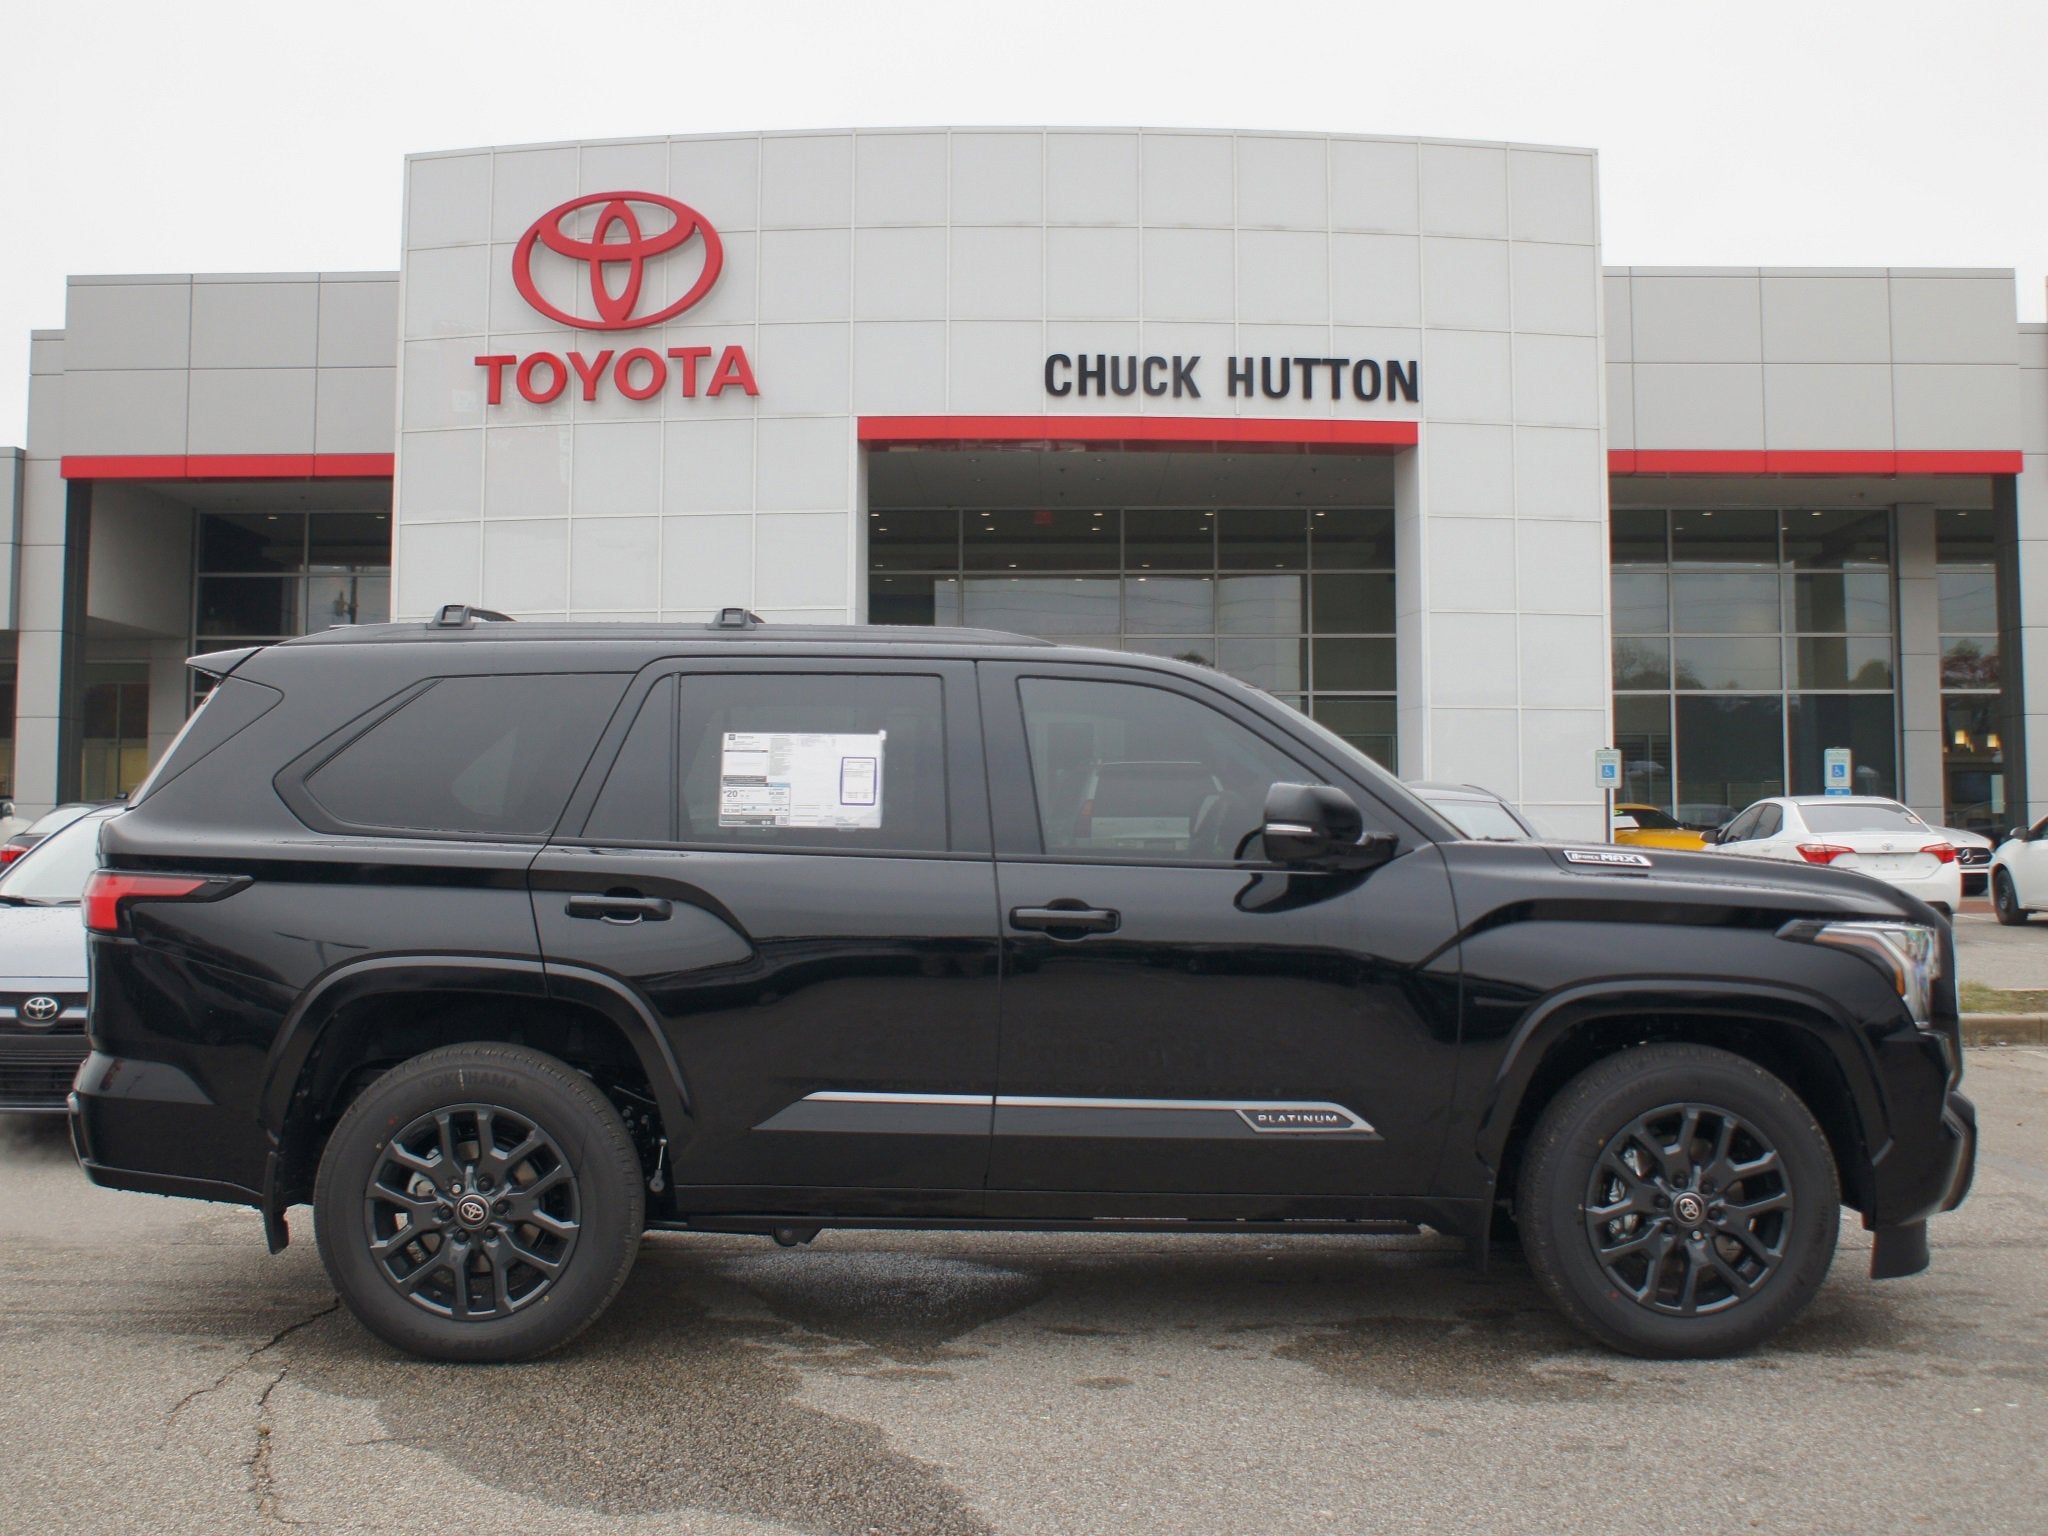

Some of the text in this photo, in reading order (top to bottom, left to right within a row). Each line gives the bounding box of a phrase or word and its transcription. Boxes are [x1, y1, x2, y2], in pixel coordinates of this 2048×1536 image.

[475, 346, 758, 404] TOYOTA
[1045, 354, 1420, 403] CHUCK HUTTON
[1600, 853, 1637, 864] MAX
[1257, 1113, 1338, 1123] PLATINUM
